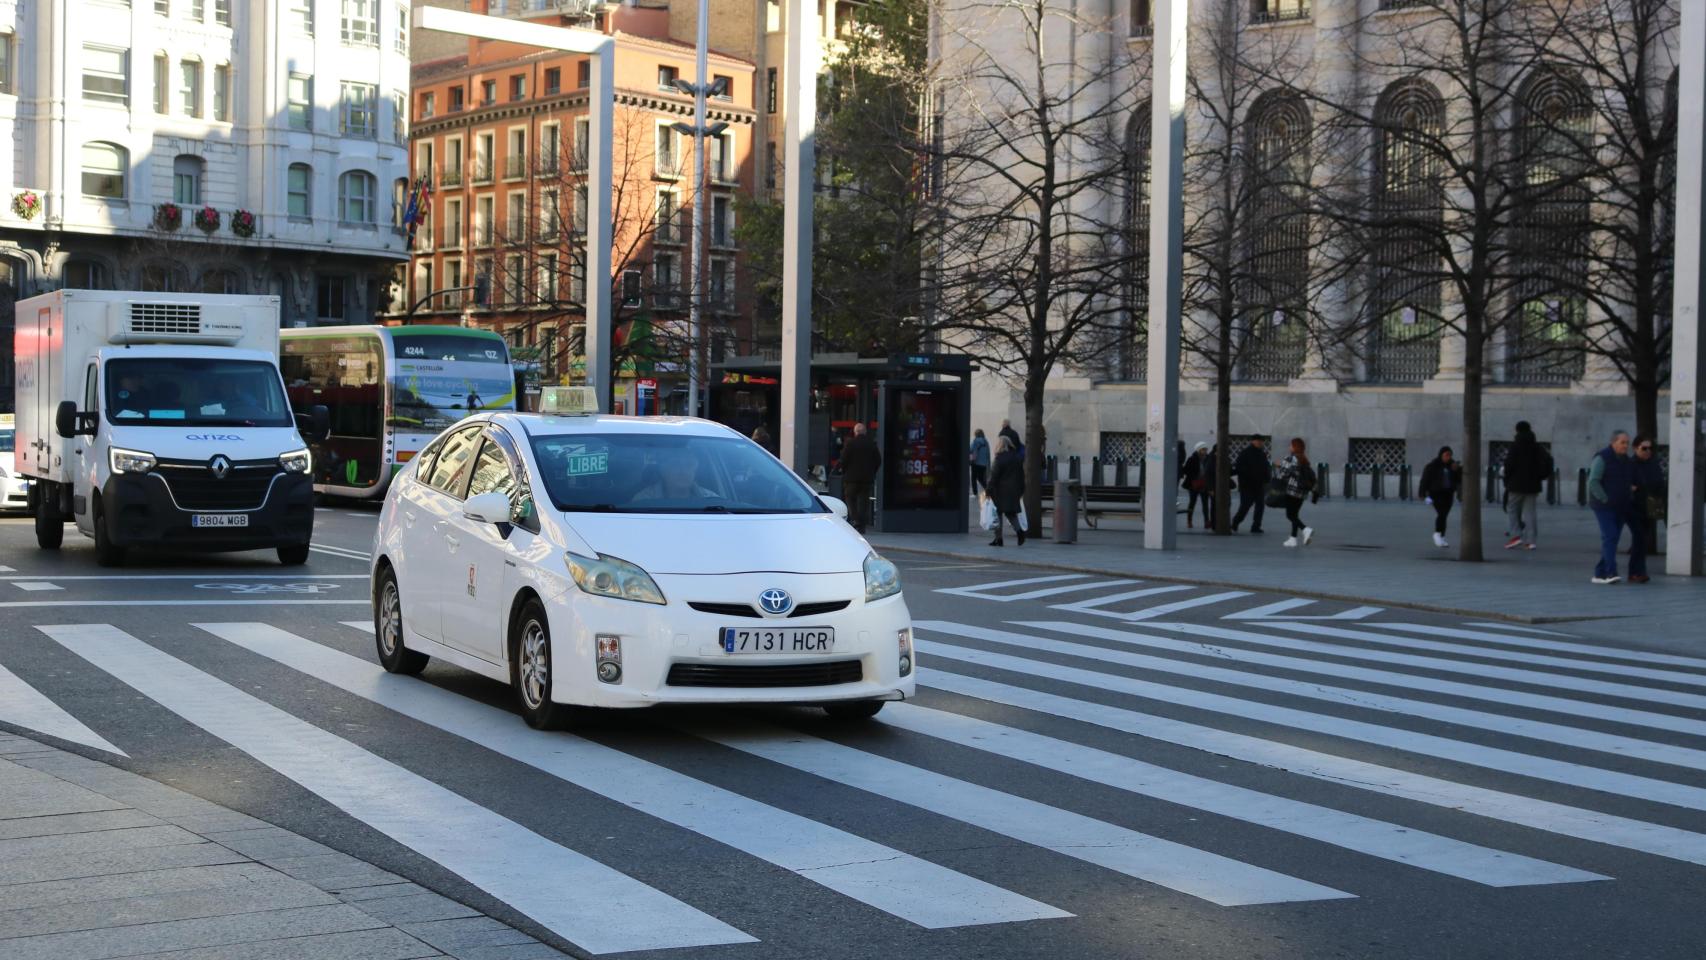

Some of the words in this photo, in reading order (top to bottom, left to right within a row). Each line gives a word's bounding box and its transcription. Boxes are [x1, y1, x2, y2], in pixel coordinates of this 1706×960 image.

[405, 346, 424, 355] 4244
[404, 377, 417, 387] We
[423, 379, 443, 389] love
[446, 382, 480, 393] cycling
[558, 390, 583, 406] TAXI
[570, 455, 606, 473] LIBRE
[199, 516, 224, 526] 9804
[227, 515, 246, 525] MGB
[739, 632, 784, 651] 7131
[793, 632, 828, 651] HCR
